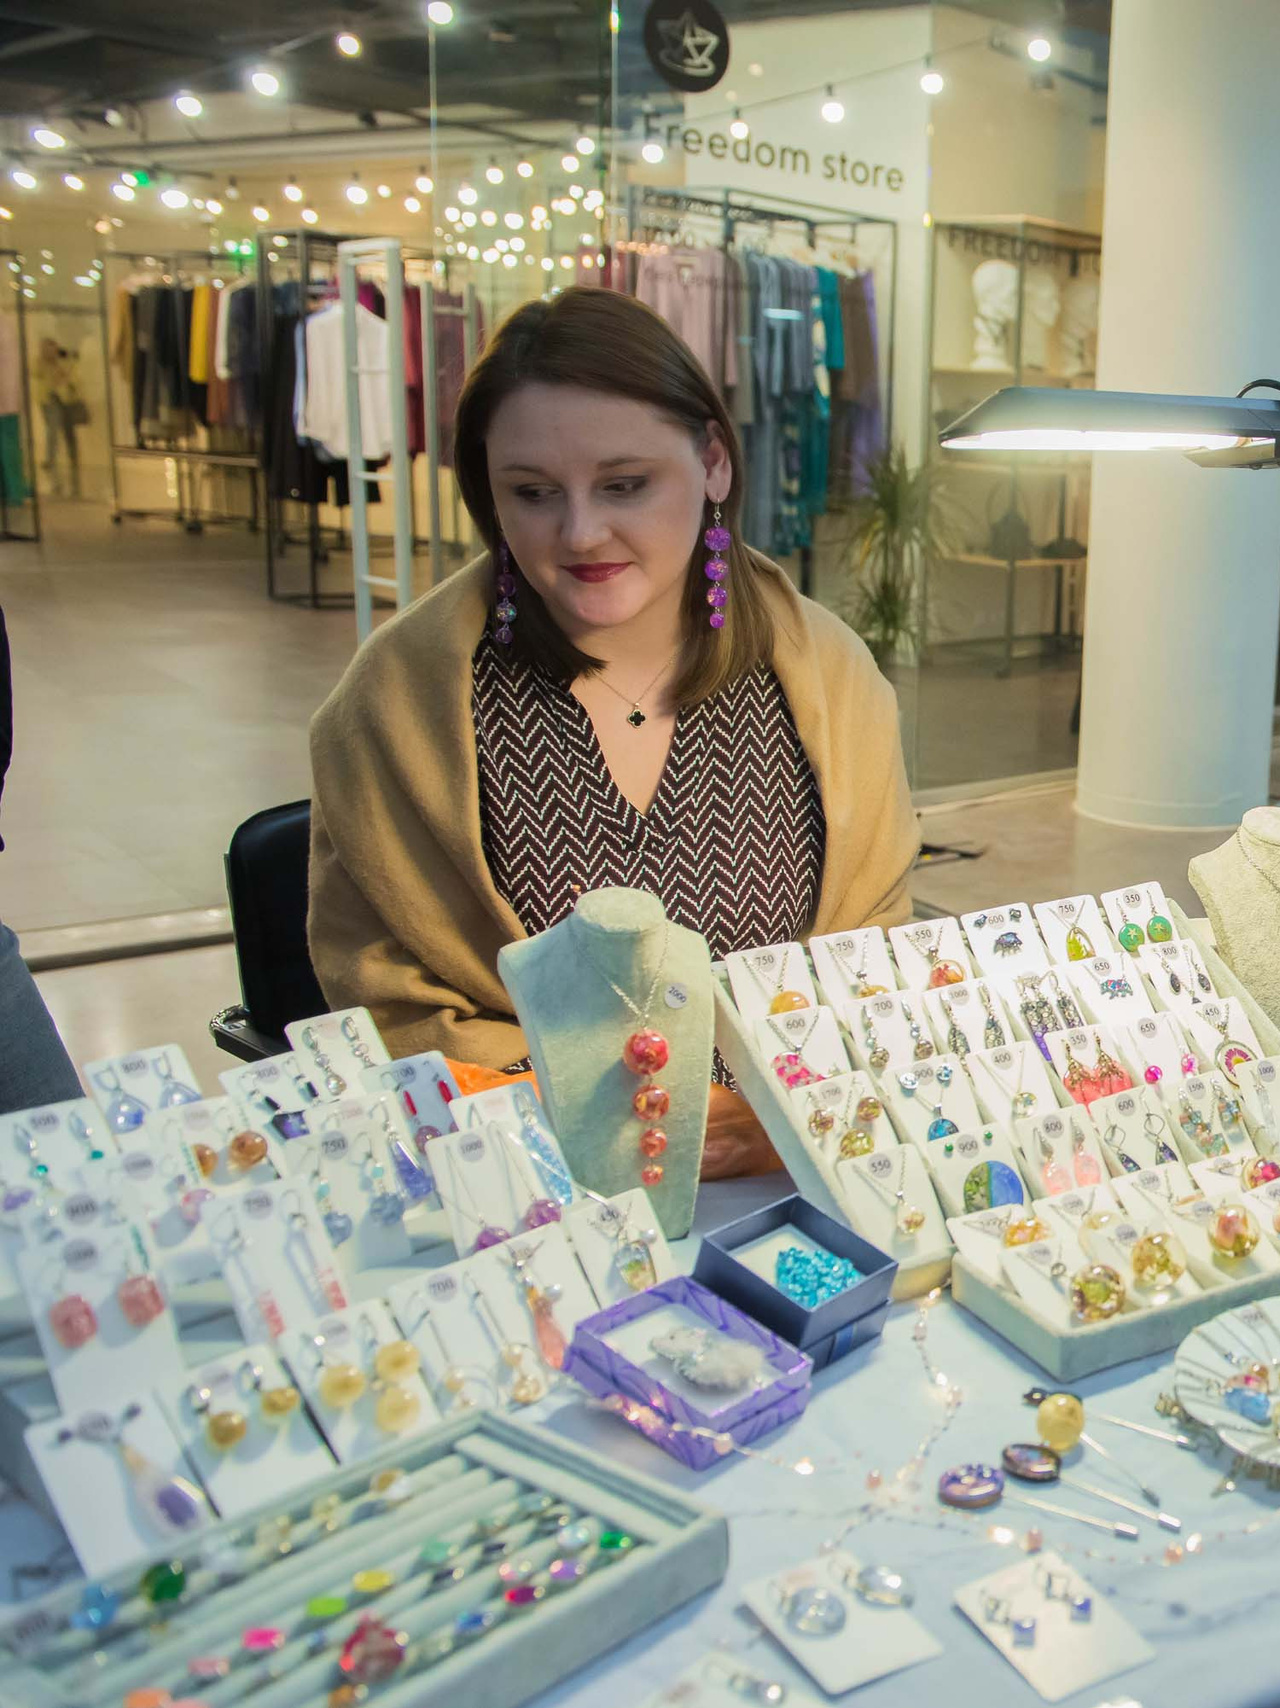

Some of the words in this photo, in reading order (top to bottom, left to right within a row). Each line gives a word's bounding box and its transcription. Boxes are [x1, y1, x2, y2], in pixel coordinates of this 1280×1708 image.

[643, 110, 810, 174] Freedom
[822, 151, 904, 193] store
[1125, 893, 1141, 904] 350
[1058, 904, 1075, 914] 750
[988, 914, 1004, 925] 600
[915, 929, 932, 940] 550
[836, 940, 854, 951] 750
[755, 954, 774, 967] 750
[1094, 961, 1110, 971] 650
[874, 1000, 892, 1012] 700
[1205, 1007, 1220, 1017] 450
[786, 1018, 804, 1029] 600
[1140, 1022, 1156, 1032] 650
[1070, 1034, 1087, 1045] 350
[994, 1053, 1011, 1063] 400
[914, 1068, 934, 1079] 900
[1258, 1065, 1274, 1076] 1000
[1118, 1099, 1134, 1111] 600
[1044, 1121, 1062, 1133] 800
[321, 1137, 346, 1154] 750
[959, 1140, 979, 1152] 900
